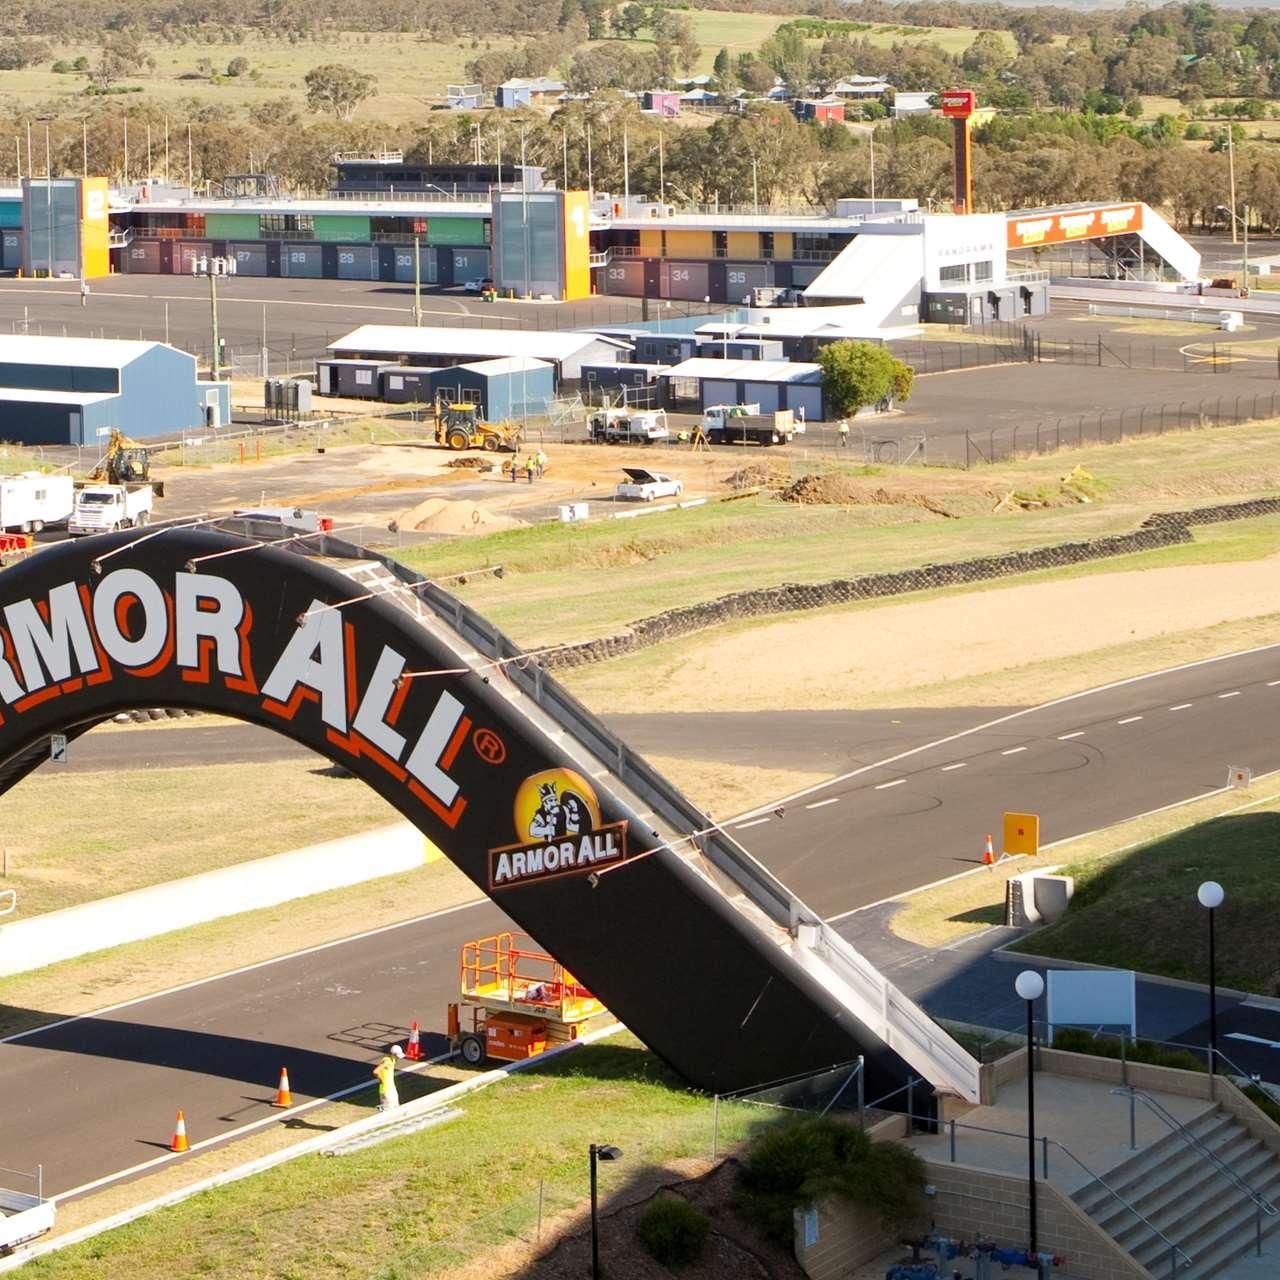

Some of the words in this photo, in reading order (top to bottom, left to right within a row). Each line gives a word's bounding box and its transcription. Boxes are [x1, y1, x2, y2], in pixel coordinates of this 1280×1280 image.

[87, 190, 105, 219] 2
[571, 206, 585, 238] 1
[4, 237, 17, 246] 23
[237, 251, 250, 261] 27
[291, 253, 306, 263] 28
[397, 255, 412, 266] 30
[455, 257, 468, 267] 31
[609, 269, 625, 280] 33
[672, 270, 690, 281] 34
[729, 272, 746, 283] 35
[261, 599, 466, 812] ALL
[495, 842, 574, 882] ARMOR
[577, 833, 618, 865] ALL
